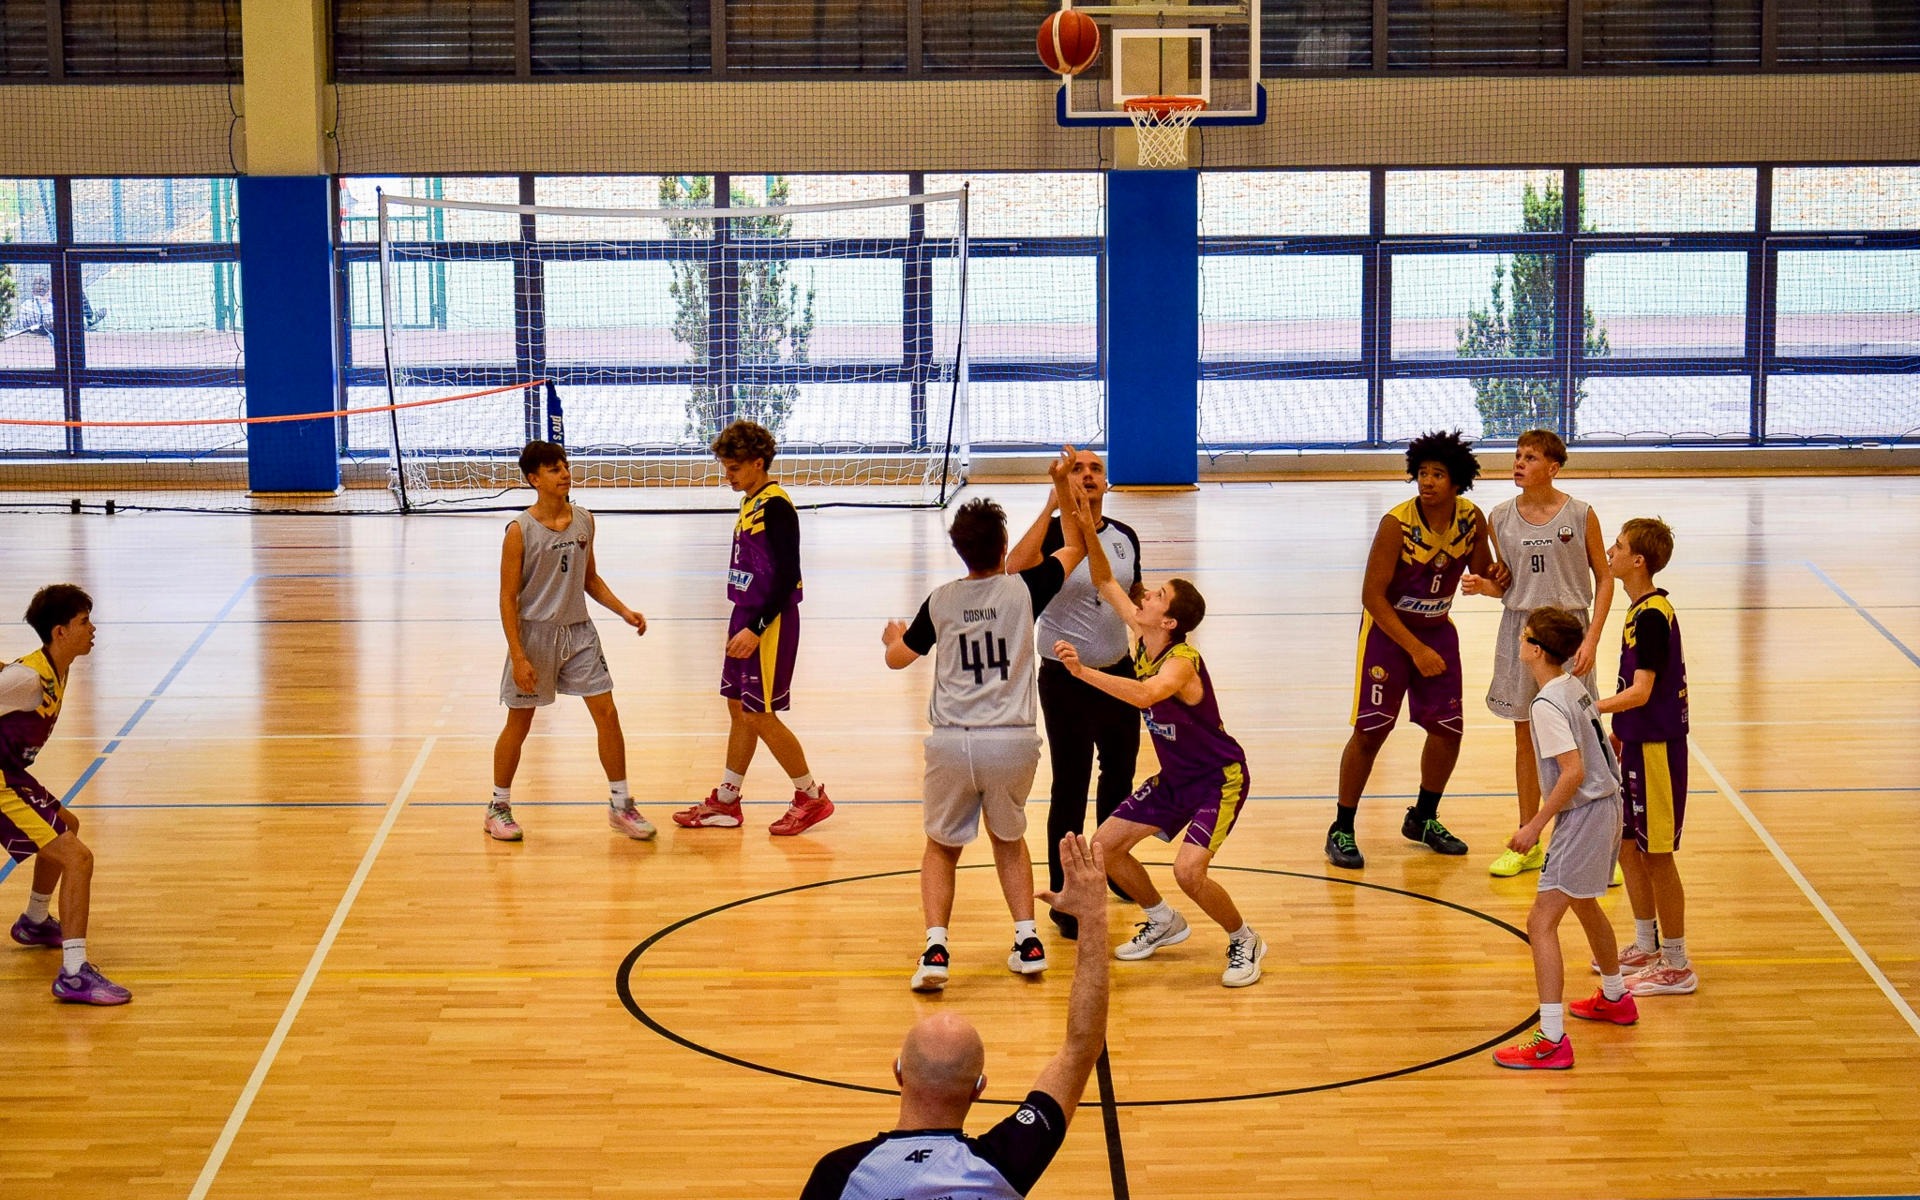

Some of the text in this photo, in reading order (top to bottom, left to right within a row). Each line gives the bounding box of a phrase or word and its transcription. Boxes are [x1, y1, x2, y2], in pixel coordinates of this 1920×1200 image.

[1531, 554, 1545, 573] 91
[1430, 574, 1443, 593] 6
[959, 630, 1010, 685] 44
[1371, 684, 1384, 706] 6
[904, 1149, 934, 1163] 4F
